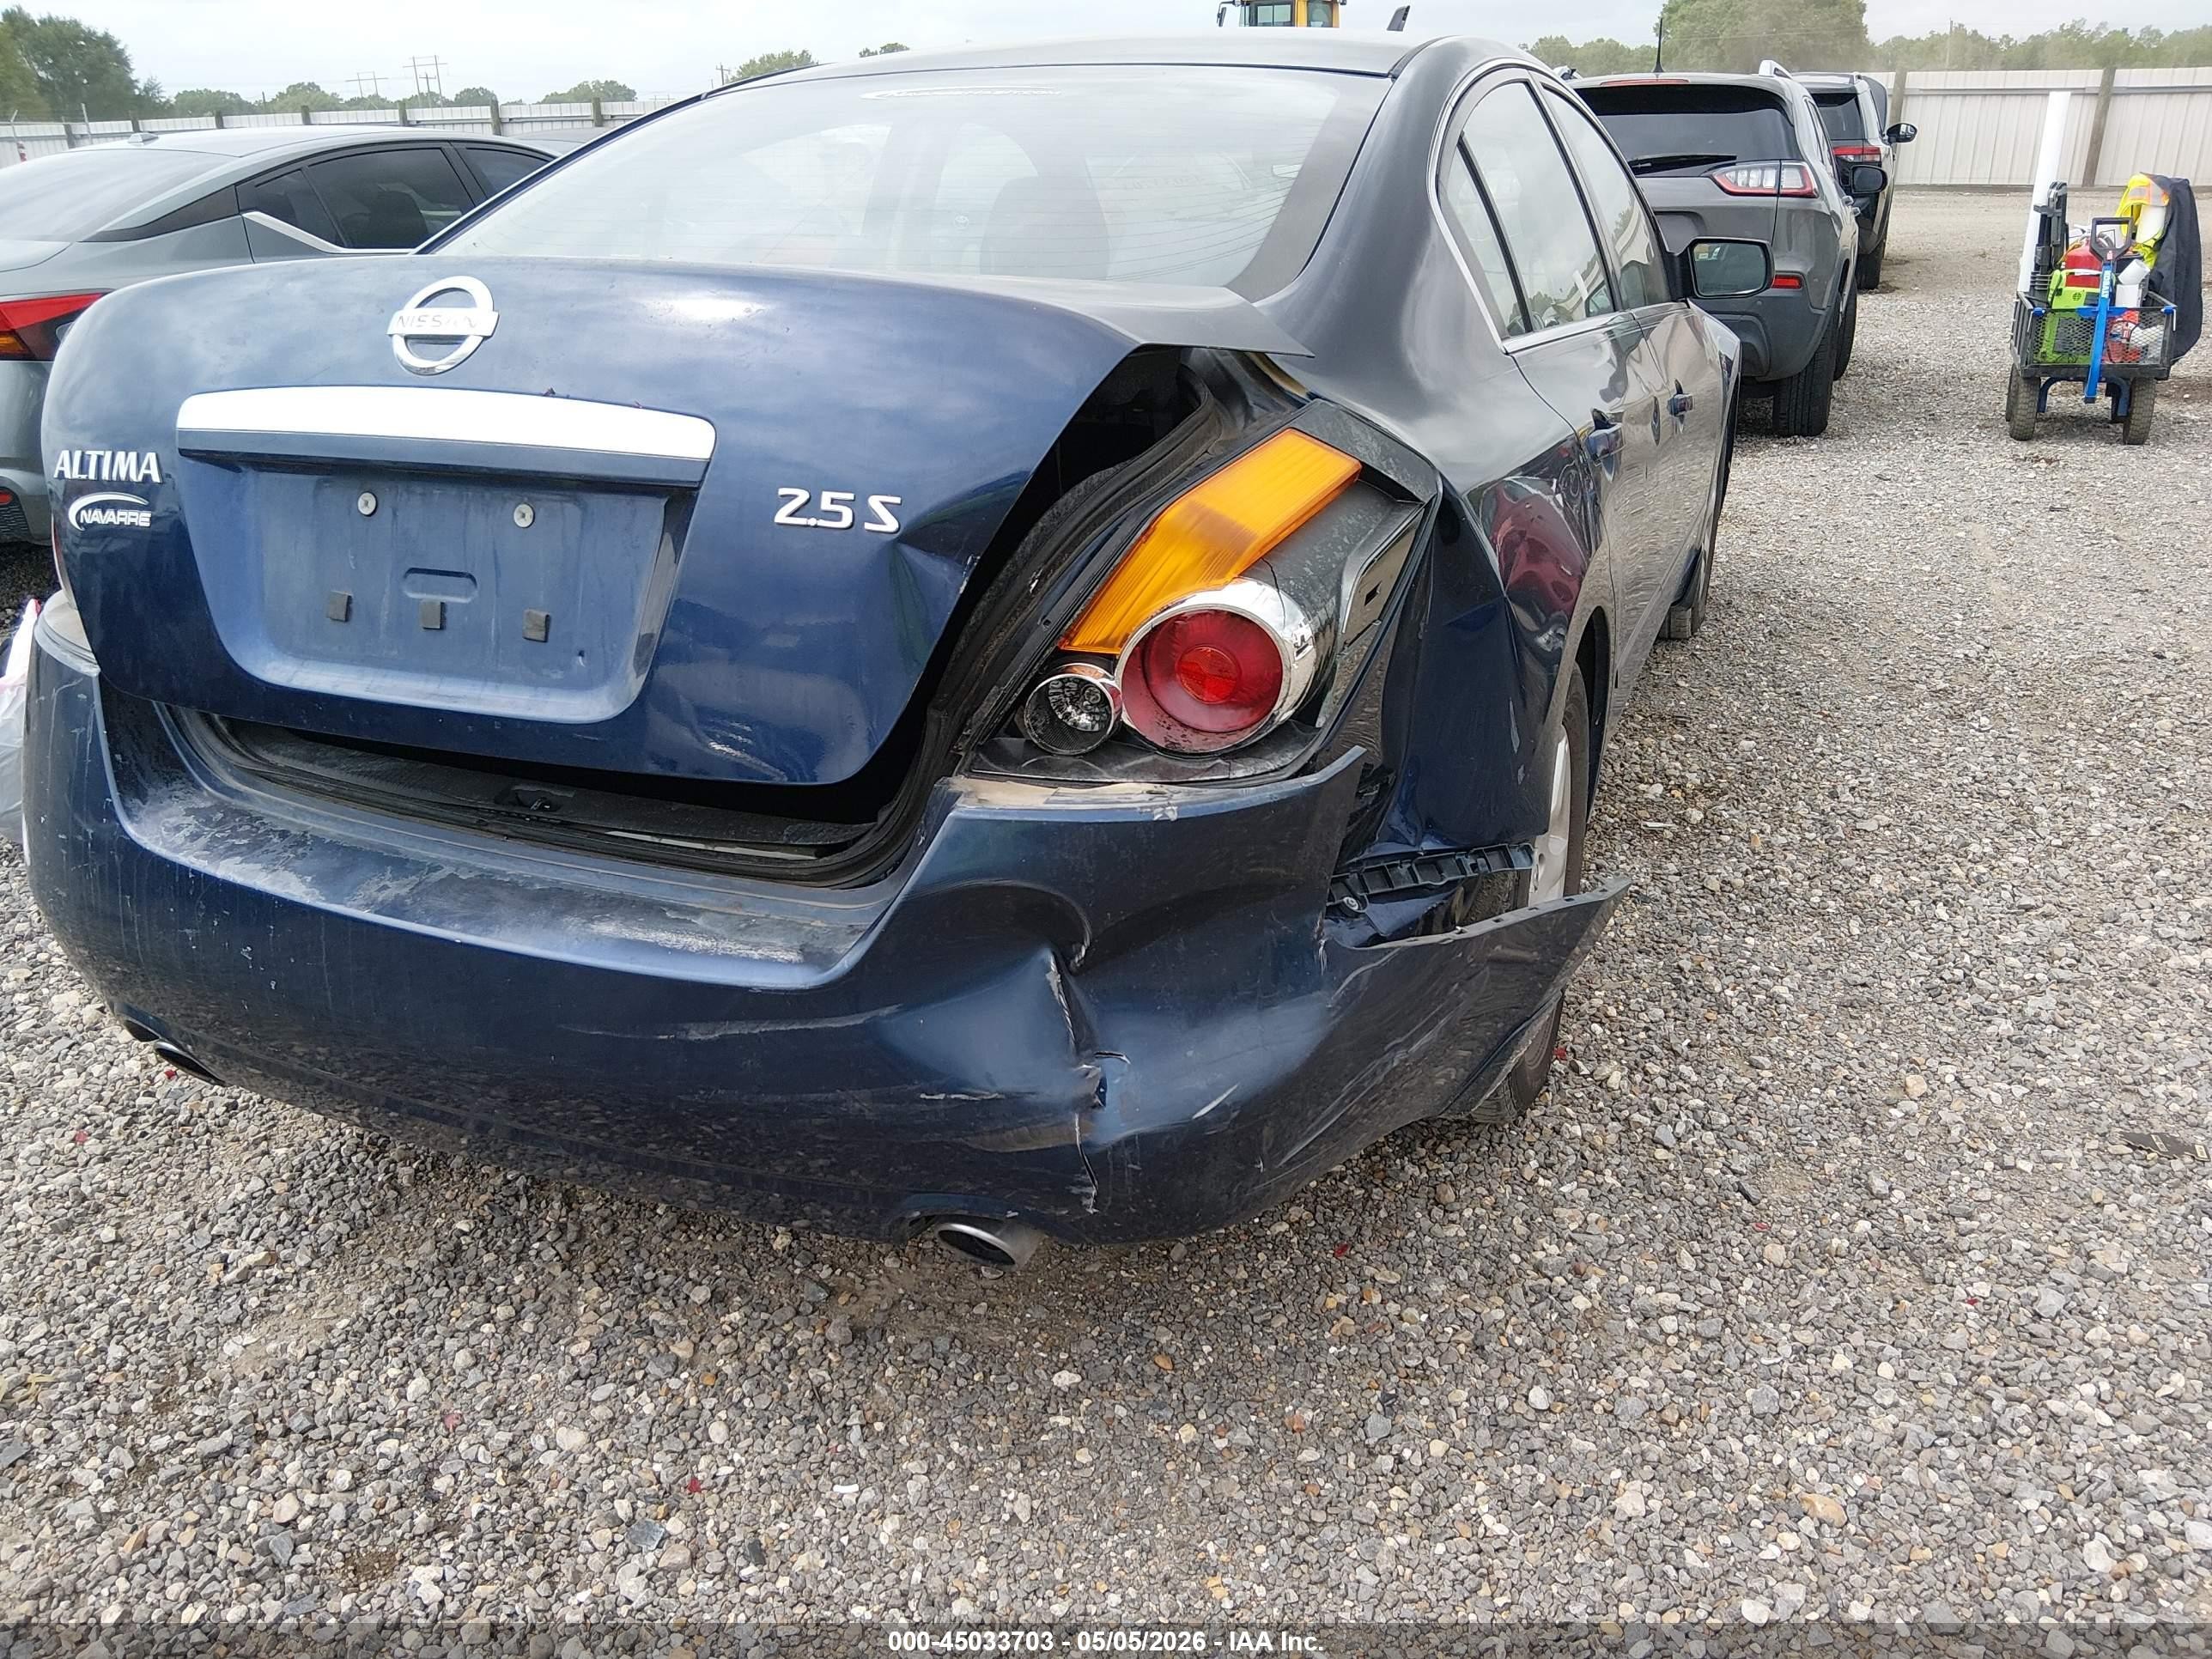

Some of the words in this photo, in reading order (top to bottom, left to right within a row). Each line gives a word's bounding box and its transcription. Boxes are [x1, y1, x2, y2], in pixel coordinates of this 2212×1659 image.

[53, 450, 162, 483] ALTIMA
[80, 508, 152, 527] NAVARRE
[774, 487, 855, 530] 2.5
[864, 495, 902, 534] S
